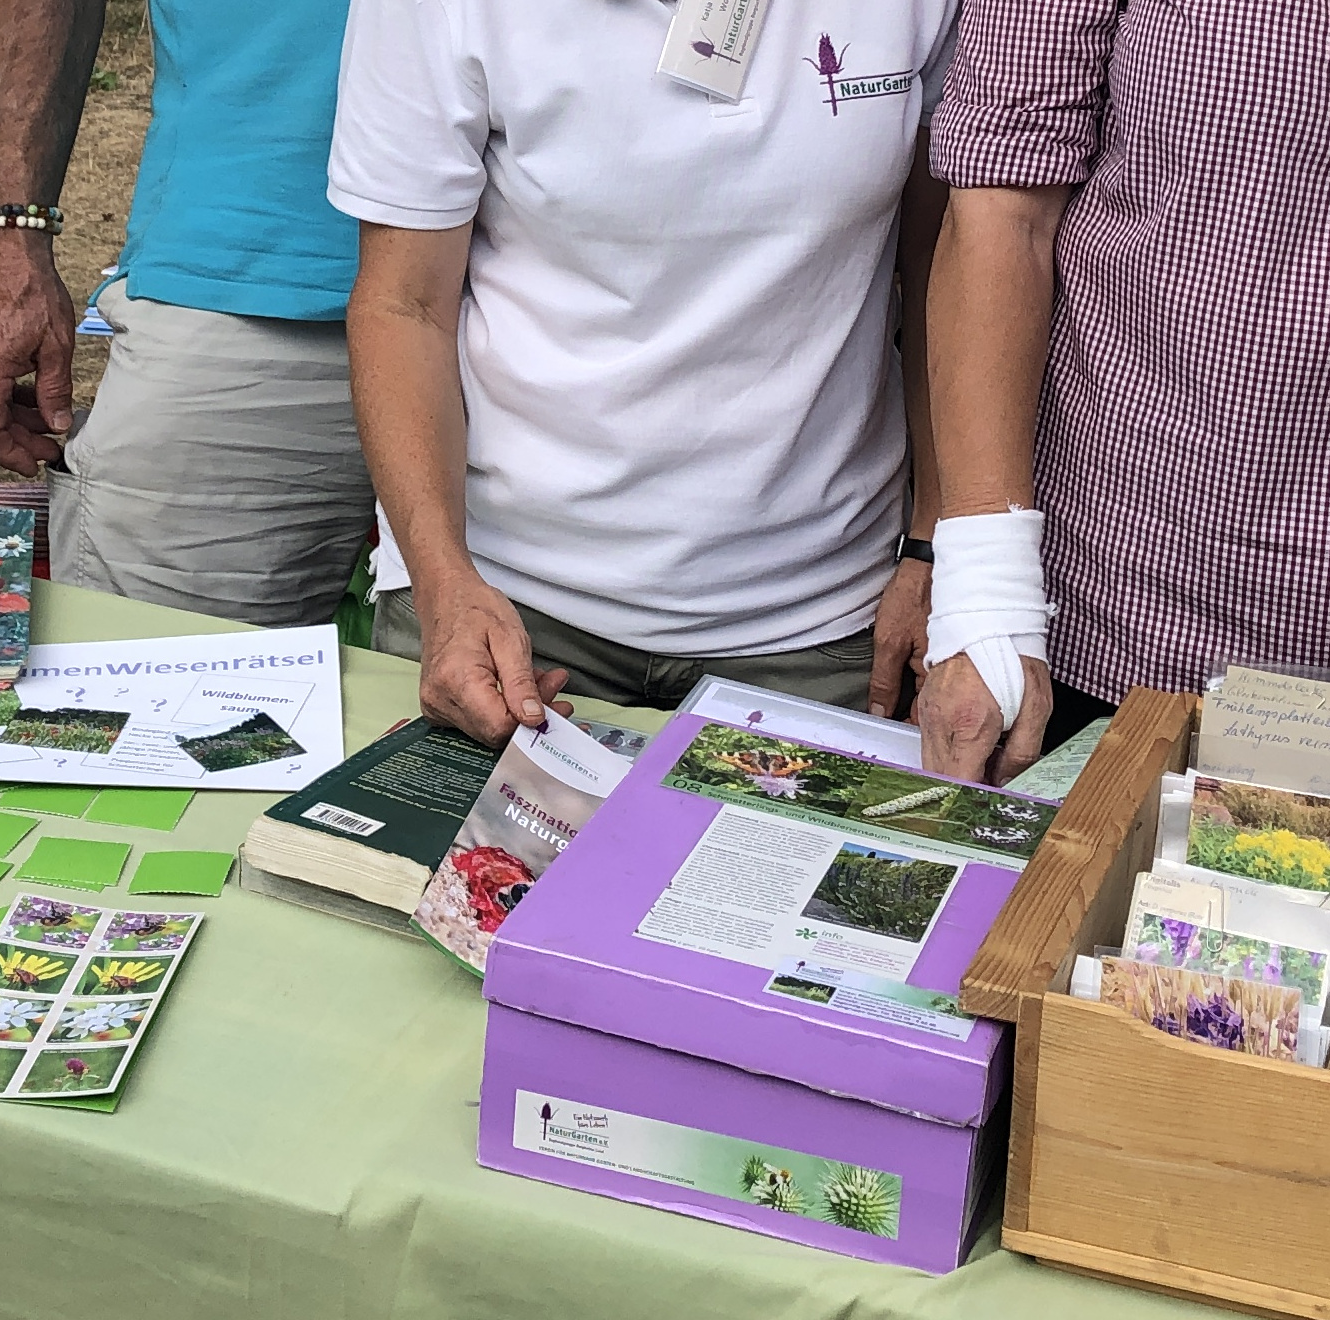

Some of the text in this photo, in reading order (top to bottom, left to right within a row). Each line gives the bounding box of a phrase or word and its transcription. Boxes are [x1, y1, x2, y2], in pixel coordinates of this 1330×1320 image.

[700, 0, 714, 23] Katja
[202, 688, 295, 705] Wildblumen-
[219, 703, 261, 716] saum
[539, 738, 590, 776] NaturGarten
[671, 778, 703, 794] 08
[785, 808, 806, 820] und
[808, 814, 891, 842] Wildbienensaum
[821, 929, 845, 941] info
[548, 1126, 599, 1144] NaturGarten
